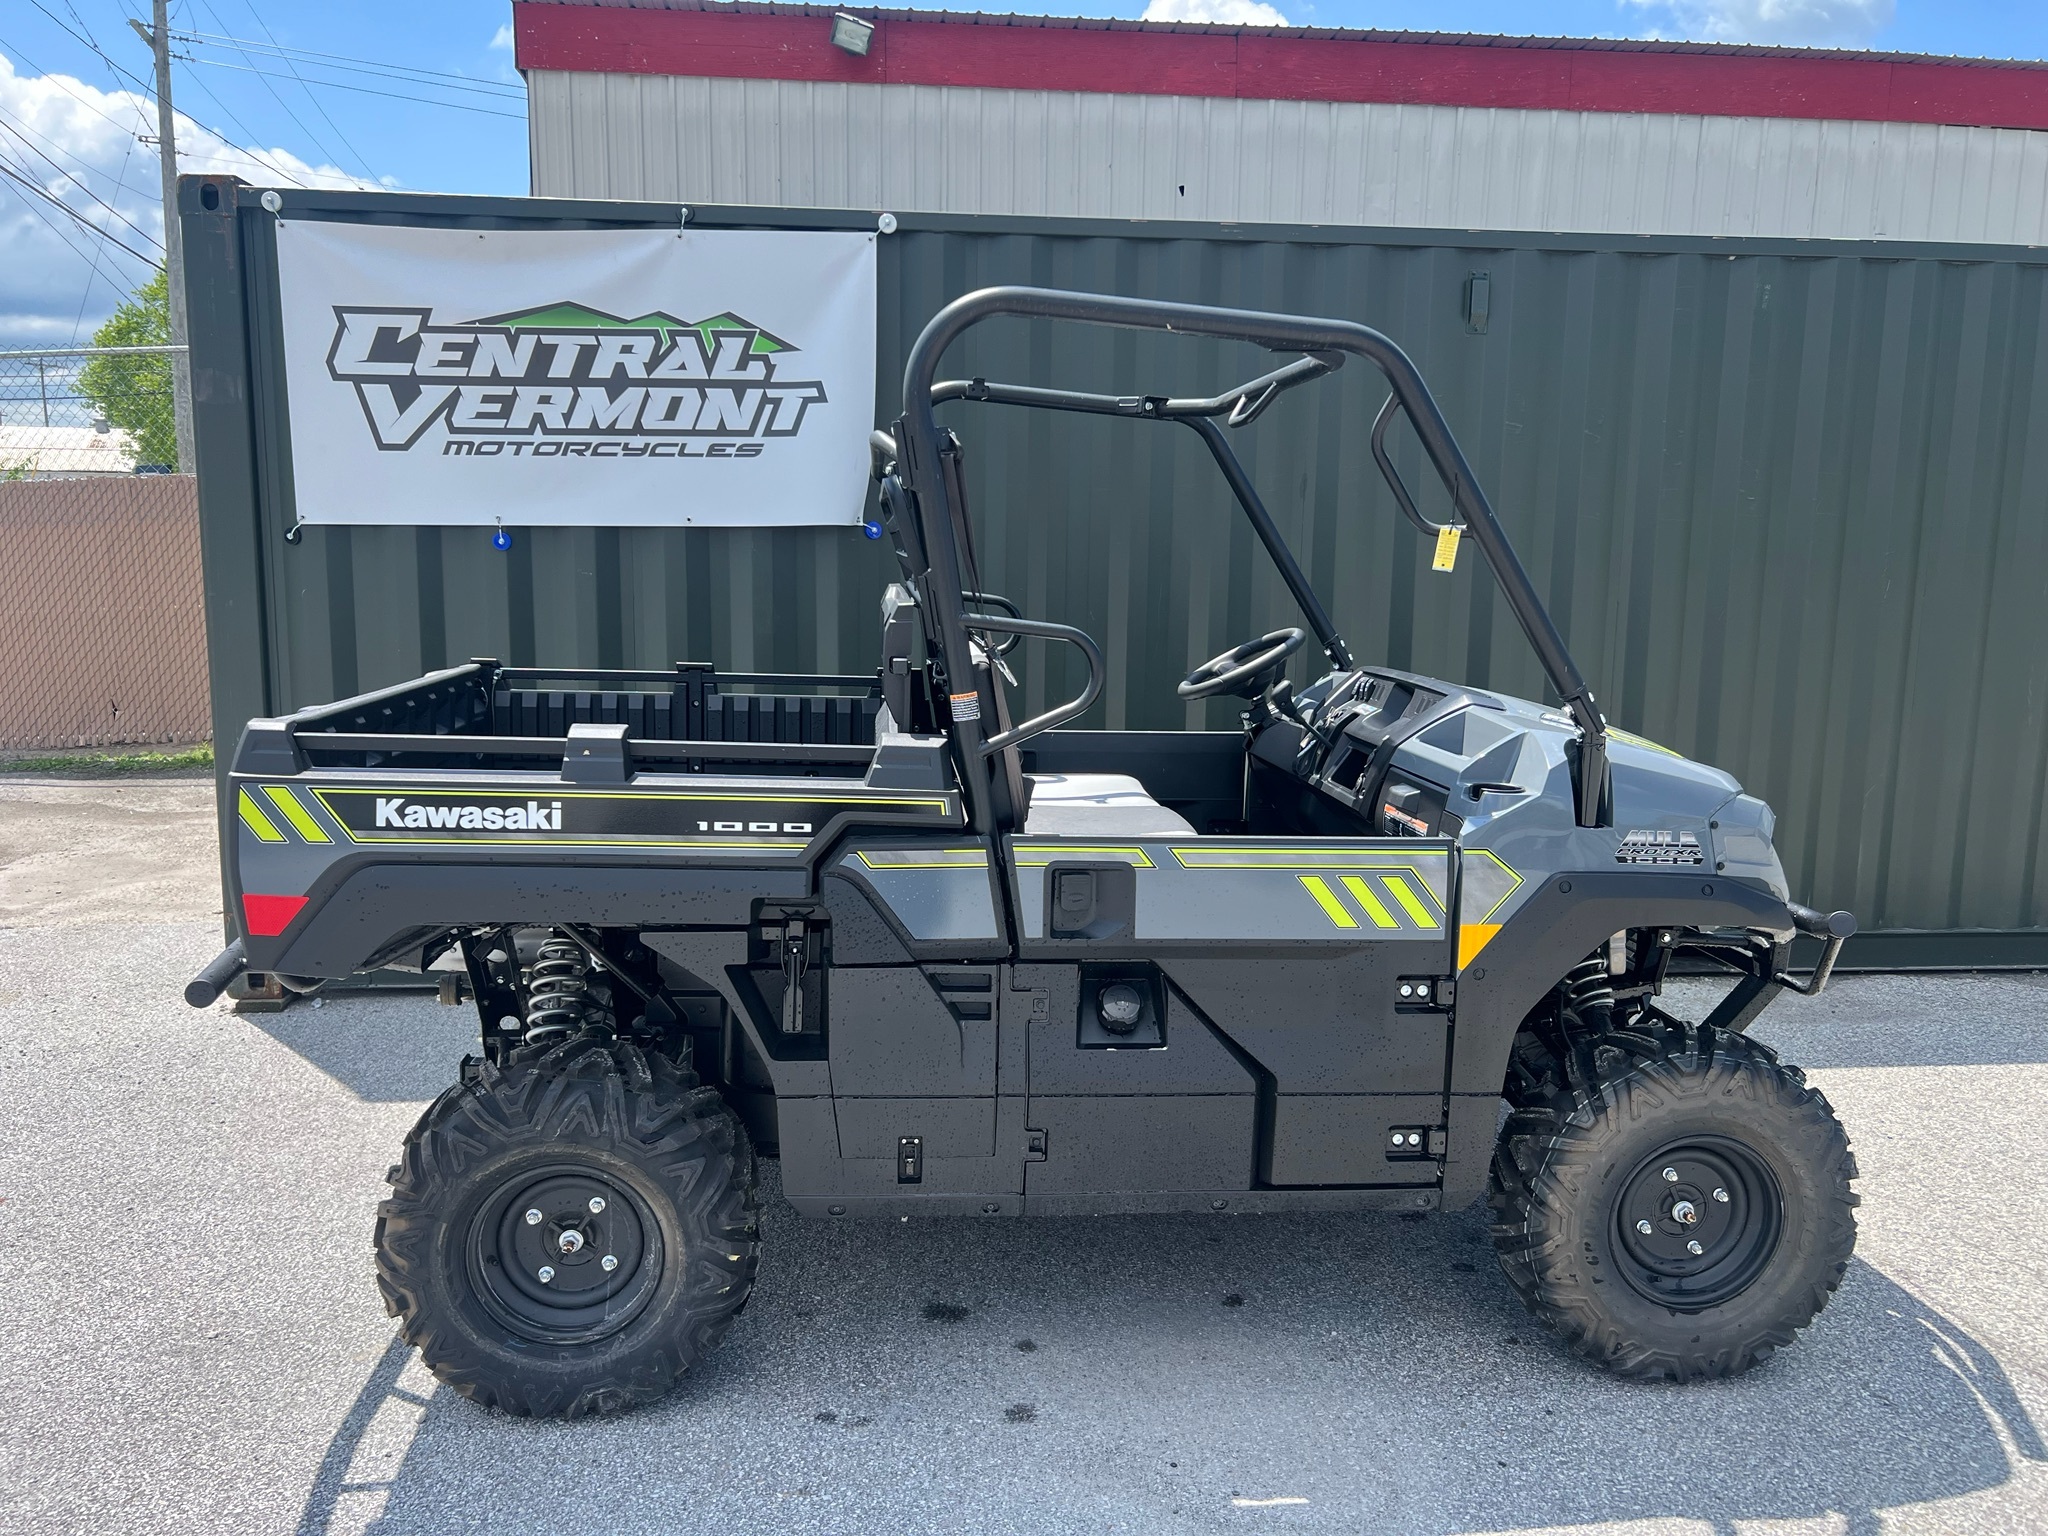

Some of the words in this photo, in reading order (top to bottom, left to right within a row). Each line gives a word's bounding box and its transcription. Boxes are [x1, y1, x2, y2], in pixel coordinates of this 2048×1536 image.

[330, 310, 770, 382] CENTRAL
[357, 381, 821, 447] VERMONT
[443, 440, 765, 457] MOTORCYCLES
[375, 797, 562, 831] Kawasaki
[696, 820, 812, 832] 1000
[1619, 829, 1700, 848] MULE
